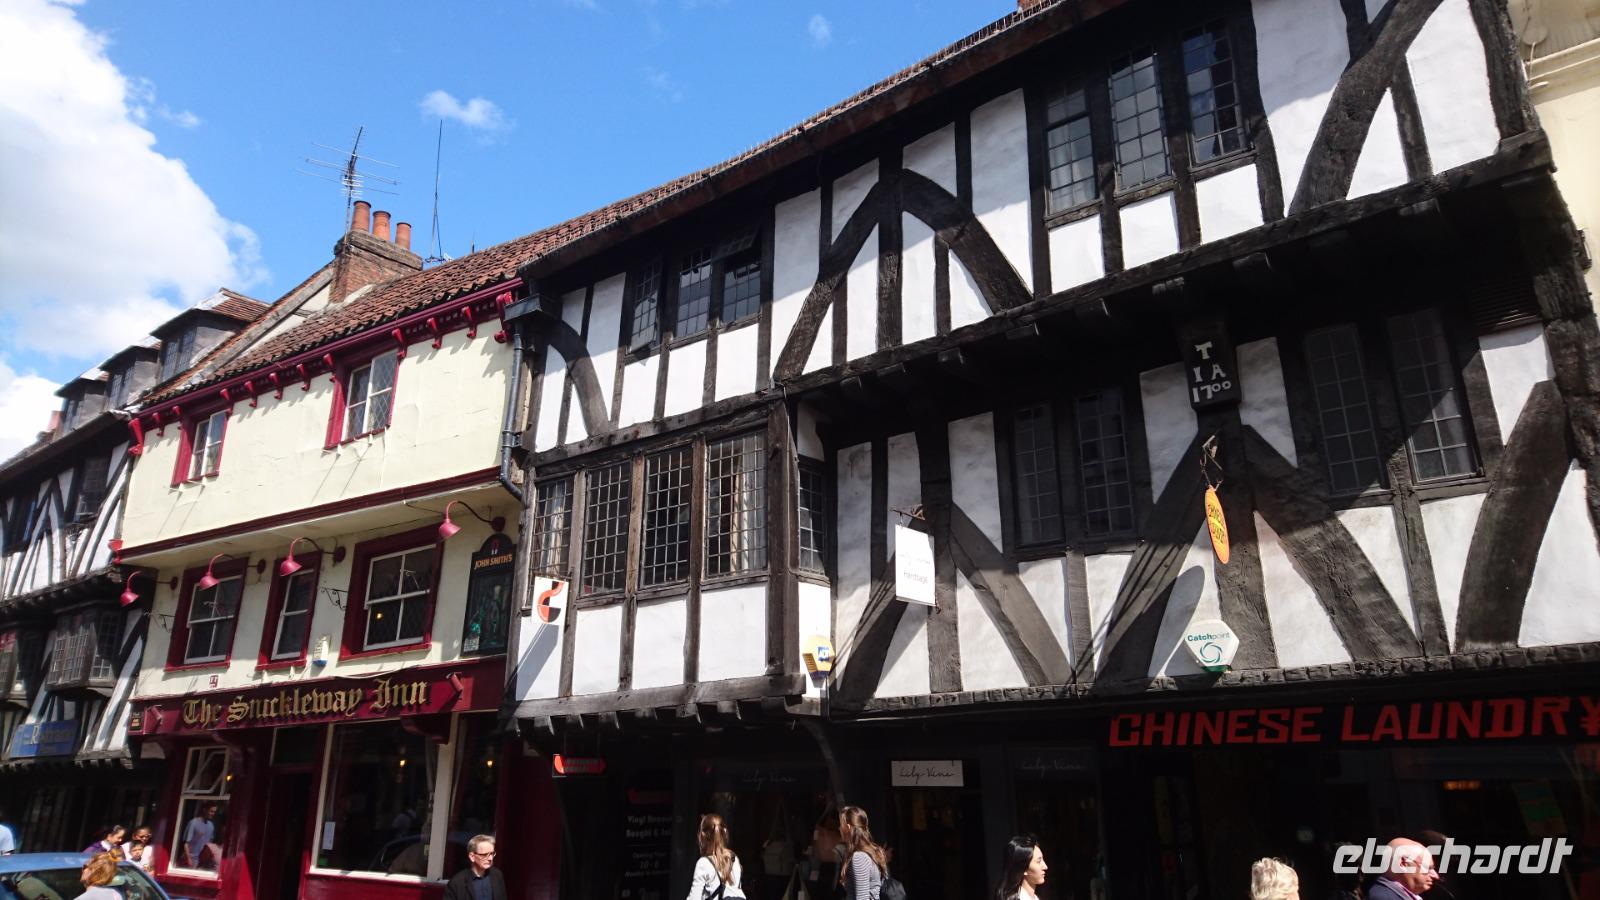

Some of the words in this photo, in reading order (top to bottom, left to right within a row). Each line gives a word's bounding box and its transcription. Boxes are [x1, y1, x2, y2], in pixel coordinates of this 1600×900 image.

[1194, 341, 1213, 360] T
[1211, 364, 1226, 381] A
[1192, 380, 1232, 403] 1700
[474, 559, 490, 570] JOHN
[1187, 632, 1231, 642] Catchpoint
[183, 697, 222, 729] The
[227, 687, 363, 723] Snickleway
[369, 678, 428, 709] Inn
[1109, 706, 1324, 747] CHINESE
